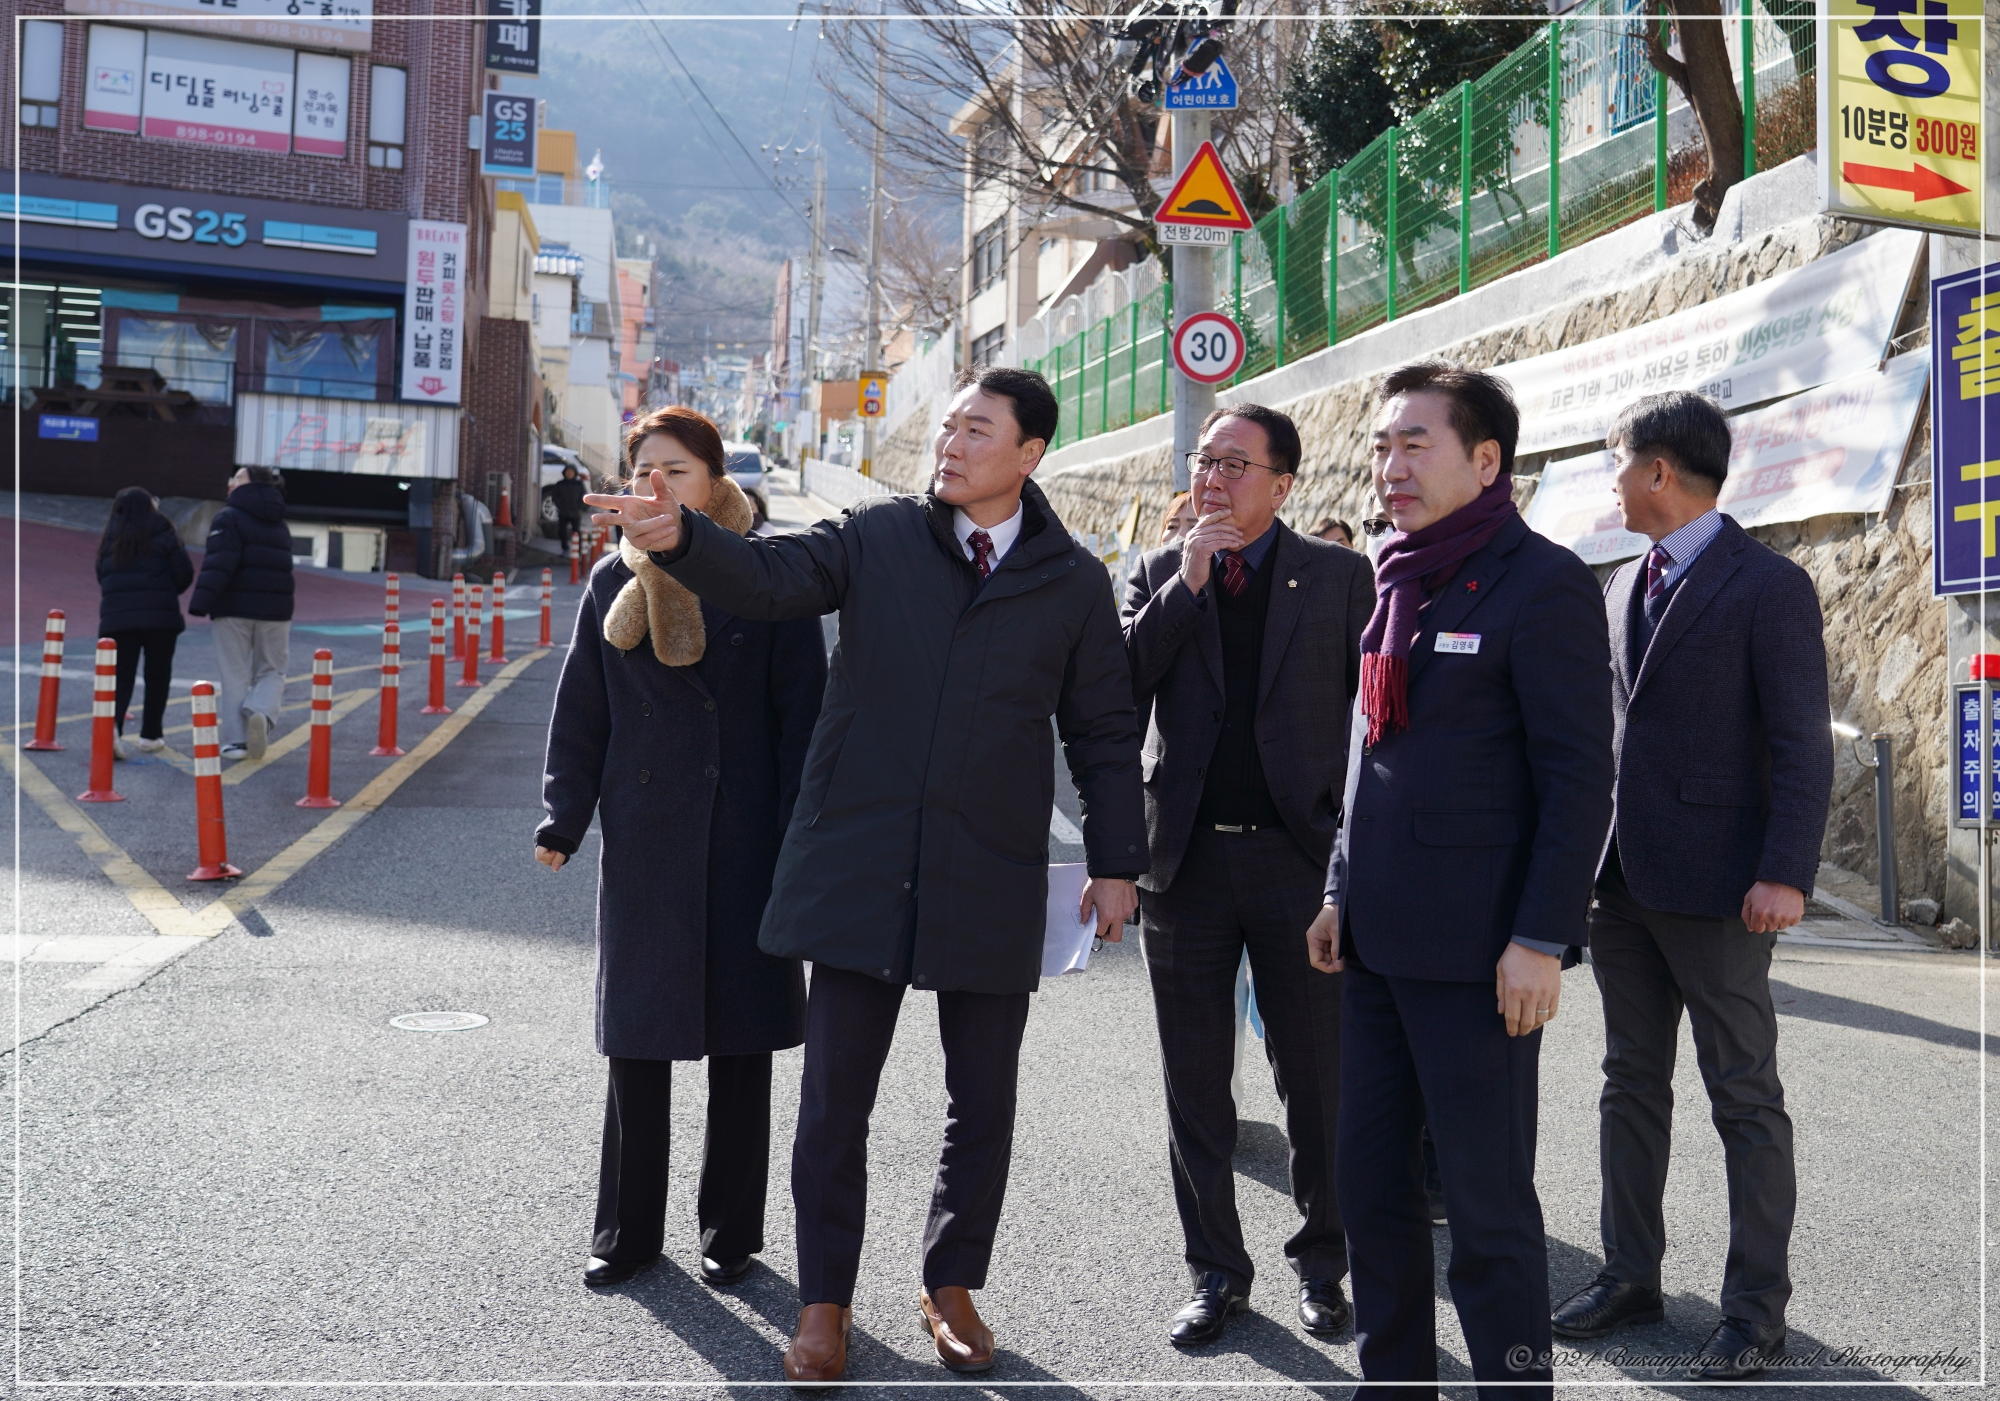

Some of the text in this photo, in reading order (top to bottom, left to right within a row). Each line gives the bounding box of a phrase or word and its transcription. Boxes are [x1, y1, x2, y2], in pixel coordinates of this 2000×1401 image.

[255, 20, 344, 44] 898-0194
[150, 71, 284, 117] 디딤돌 러닝스쿨
[1171, 94, 1231, 106] 어린이보호
[303, 100, 339, 115] 전과목
[494, 100, 527, 122] GS
[175, 125, 257, 146] 898-0194
[494, 120, 527, 142] 25
[1841, 105, 1976, 161] 10분당 300원
[134, 203, 247, 247] GS25
[417, 228, 460, 243] BREATH
[1190, 331, 1227, 363] 30
[1733, 305, 1814, 367] 인성역량
[439, 327, 454, 371] 전문점
[424, 379, 439, 391] B1
[1451, 640, 1475, 650] 김영욱
